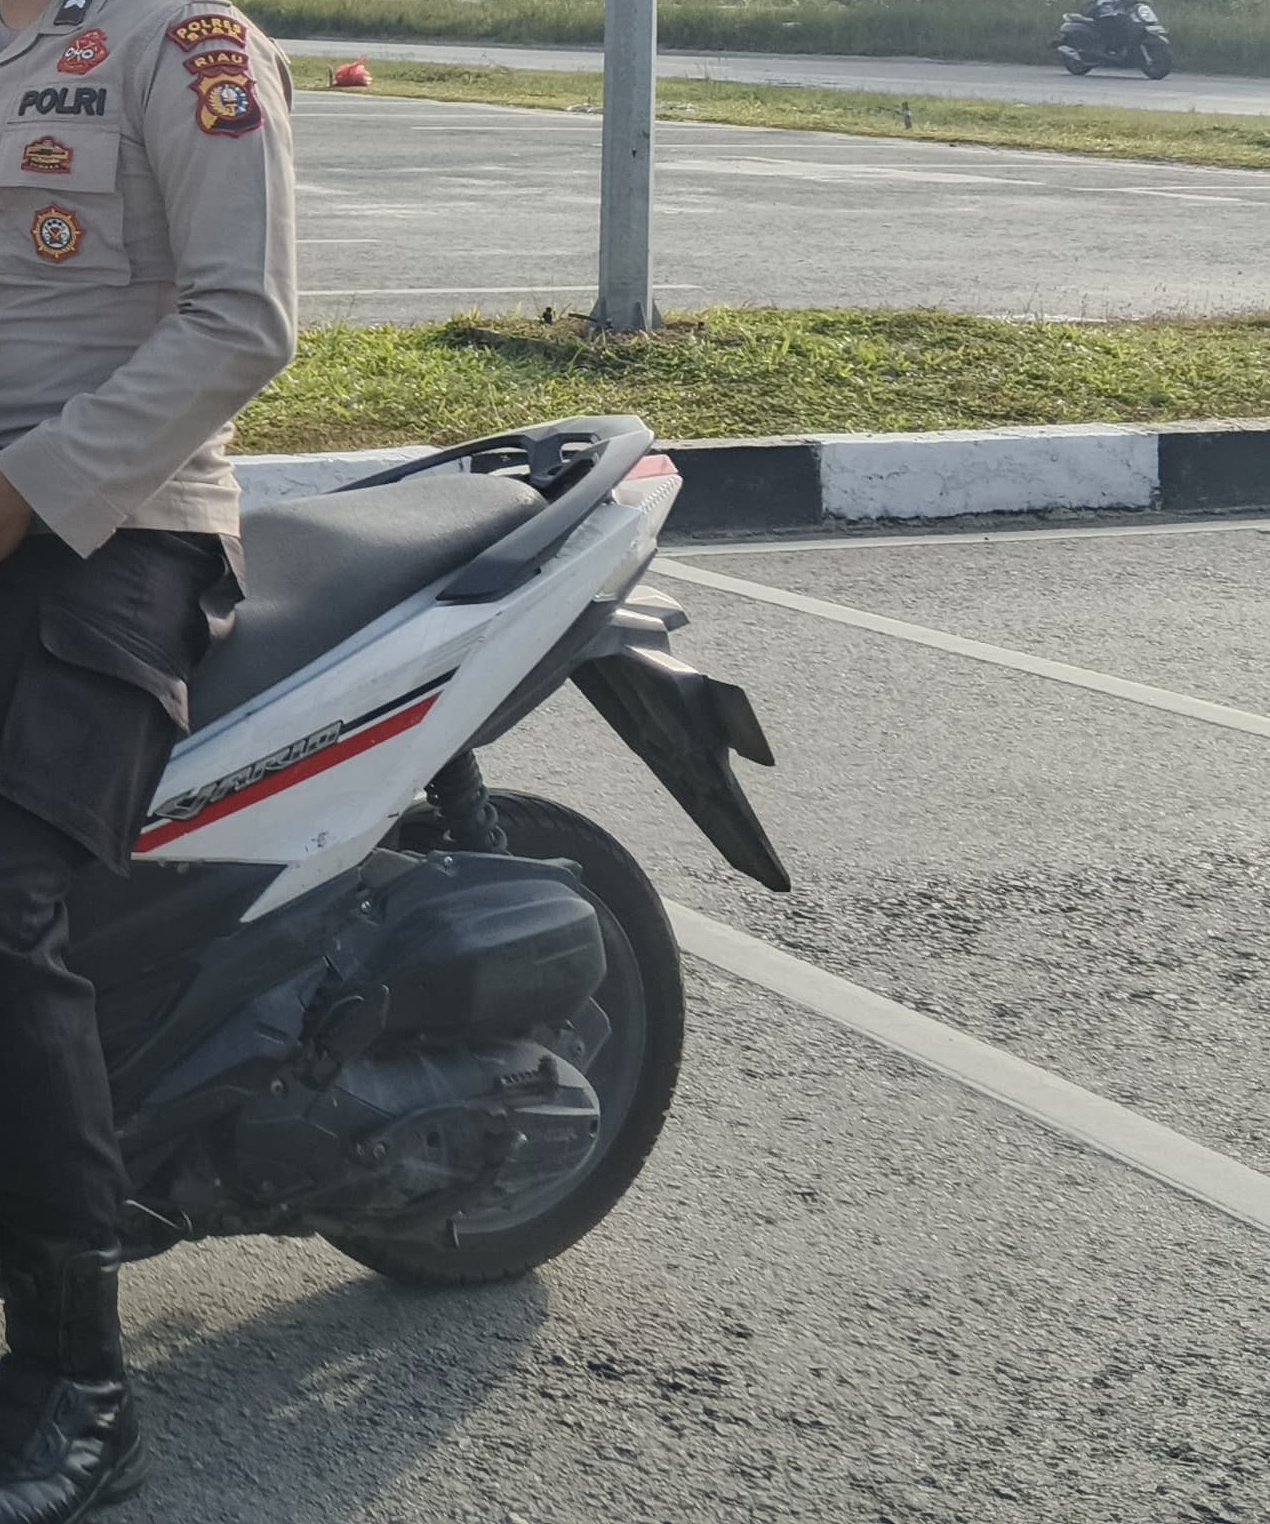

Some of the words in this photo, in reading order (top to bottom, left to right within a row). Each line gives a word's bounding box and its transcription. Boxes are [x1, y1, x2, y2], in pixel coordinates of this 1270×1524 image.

[176, 18, 242, 40] POLRES
[194, 52, 243, 67] RIAU
[18, 86, 107, 117] POLRI
